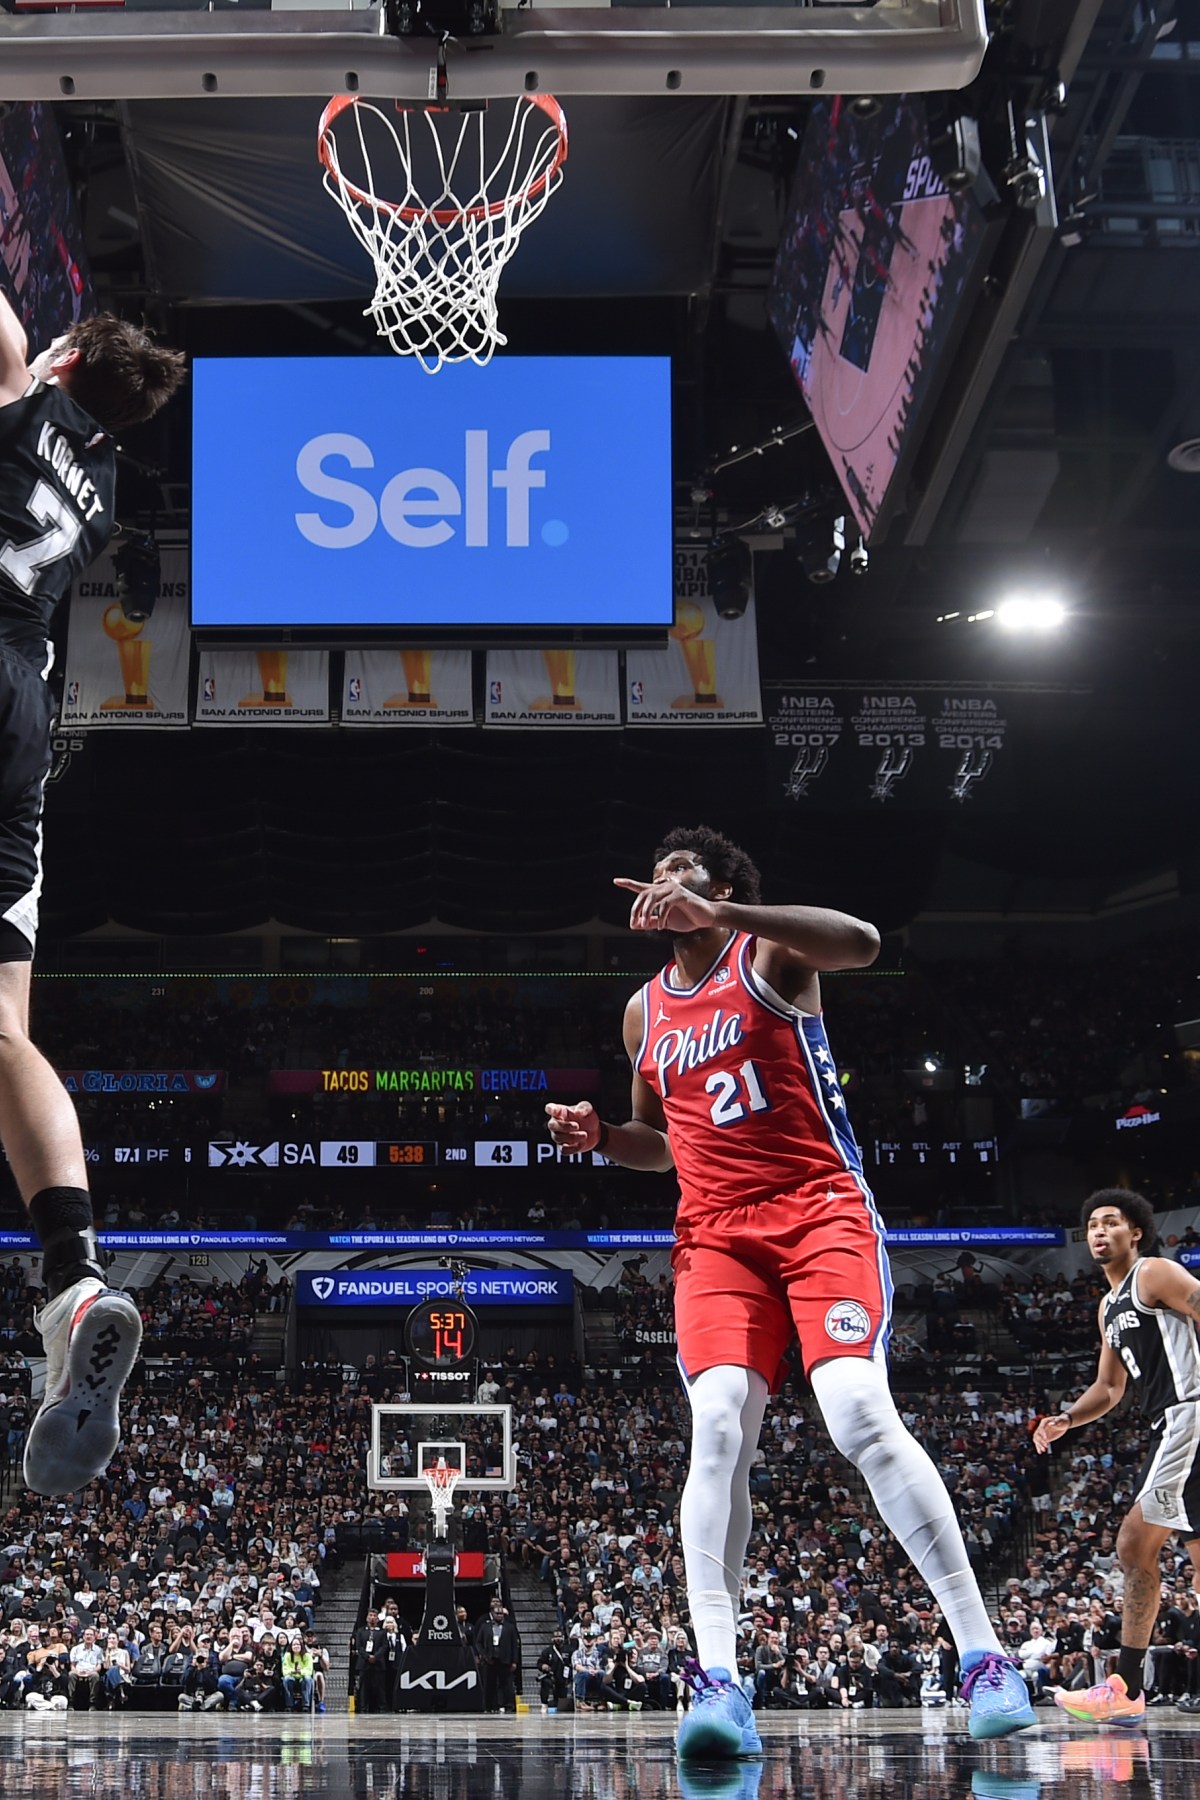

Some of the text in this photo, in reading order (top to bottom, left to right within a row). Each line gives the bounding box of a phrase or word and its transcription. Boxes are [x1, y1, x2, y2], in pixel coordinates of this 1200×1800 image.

[37, 421, 104, 521] KORNET
[295, 429, 569, 549] Self.
[789, 697, 834, 708] NBA
[871, 697, 917, 708] NBA
[952, 699, 997, 711] NBA
[64, 711, 185, 720] SAN ANTONIO SPURS
[201, 708, 324, 716] SAN ANTONIO SPURS
[346, 708, 470, 718] SAN ANTONIO SPURS
[491, 711, 616, 721] SAN ANTONIO SPURS
[631, 711, 758, 720] SAN ANTONIO SPURS
[778, 708, 834, 716] WESTERN
[860, 708, 917, 716] WESTERN
[940, 710, 997, 718] WESTERN
[769, 716, 844, 724] CONFERENCE
[851, 716, 926, 724] CONFERENCE
[931, 718, 1007, 727] CONFERENCE
[772, 724, 842, 732] CHAMPIONS
[855, 723, 925, 732] CHAMPIONS
[935, 726, 1005, 735] CHAMPIONS
[775, 734, 840, 746] 2007
[859, 734, 926, 746] 2013
[939, 735, 1003, 749] 2014
[151, 987, 165, 996] 231
[419, 987, 434, 996] 200
[653, 1009, 743, 1098] Phila
[82, 1071, 189, 1092] GLORIA
[322, 1070, 548, 1091] TACOS MARGARITAS CERVEZA
[705, 1060, 769, 1127] 21
[973, 1141, 993, 1149] REB
[114, 1148, 140, 1163] 57.1
[146, 1149, 169, 1161] PF
[184, 1149, 191, 1163] 5
[283, 1143, 316, 1164] SA
[337, 1145, 359, 1164] 49
[389, 1145, 424, 1163] 5:38
[445, 1149, 467, 1161] 2ND
[491, 1145, 513, 1164] 43
[889, 1152, 894, 1163] 2
[587, 1235, 608, 1243] WATCH
[609, 1235, 621, 1243] THE
[622, 1235, 642, 1243] SPURS
[642, 1235, 653, 1243] ALL
[191, 1255, 208, 1265] 128
[338, 1281, 414, 1295] FANDUEL
[481, 1281, 558, 1295] NETWORK
[430, 1313, 465, 1329] 5:37
[831, 1317, 866, 1335] 76ers
[434, 1331, 464, 1359] 14
[1121, 1346, 1142, 1379] 2
[430, 1372, 470, 1381] TISSOT
[428, 1629, 453, 1640] Frost
